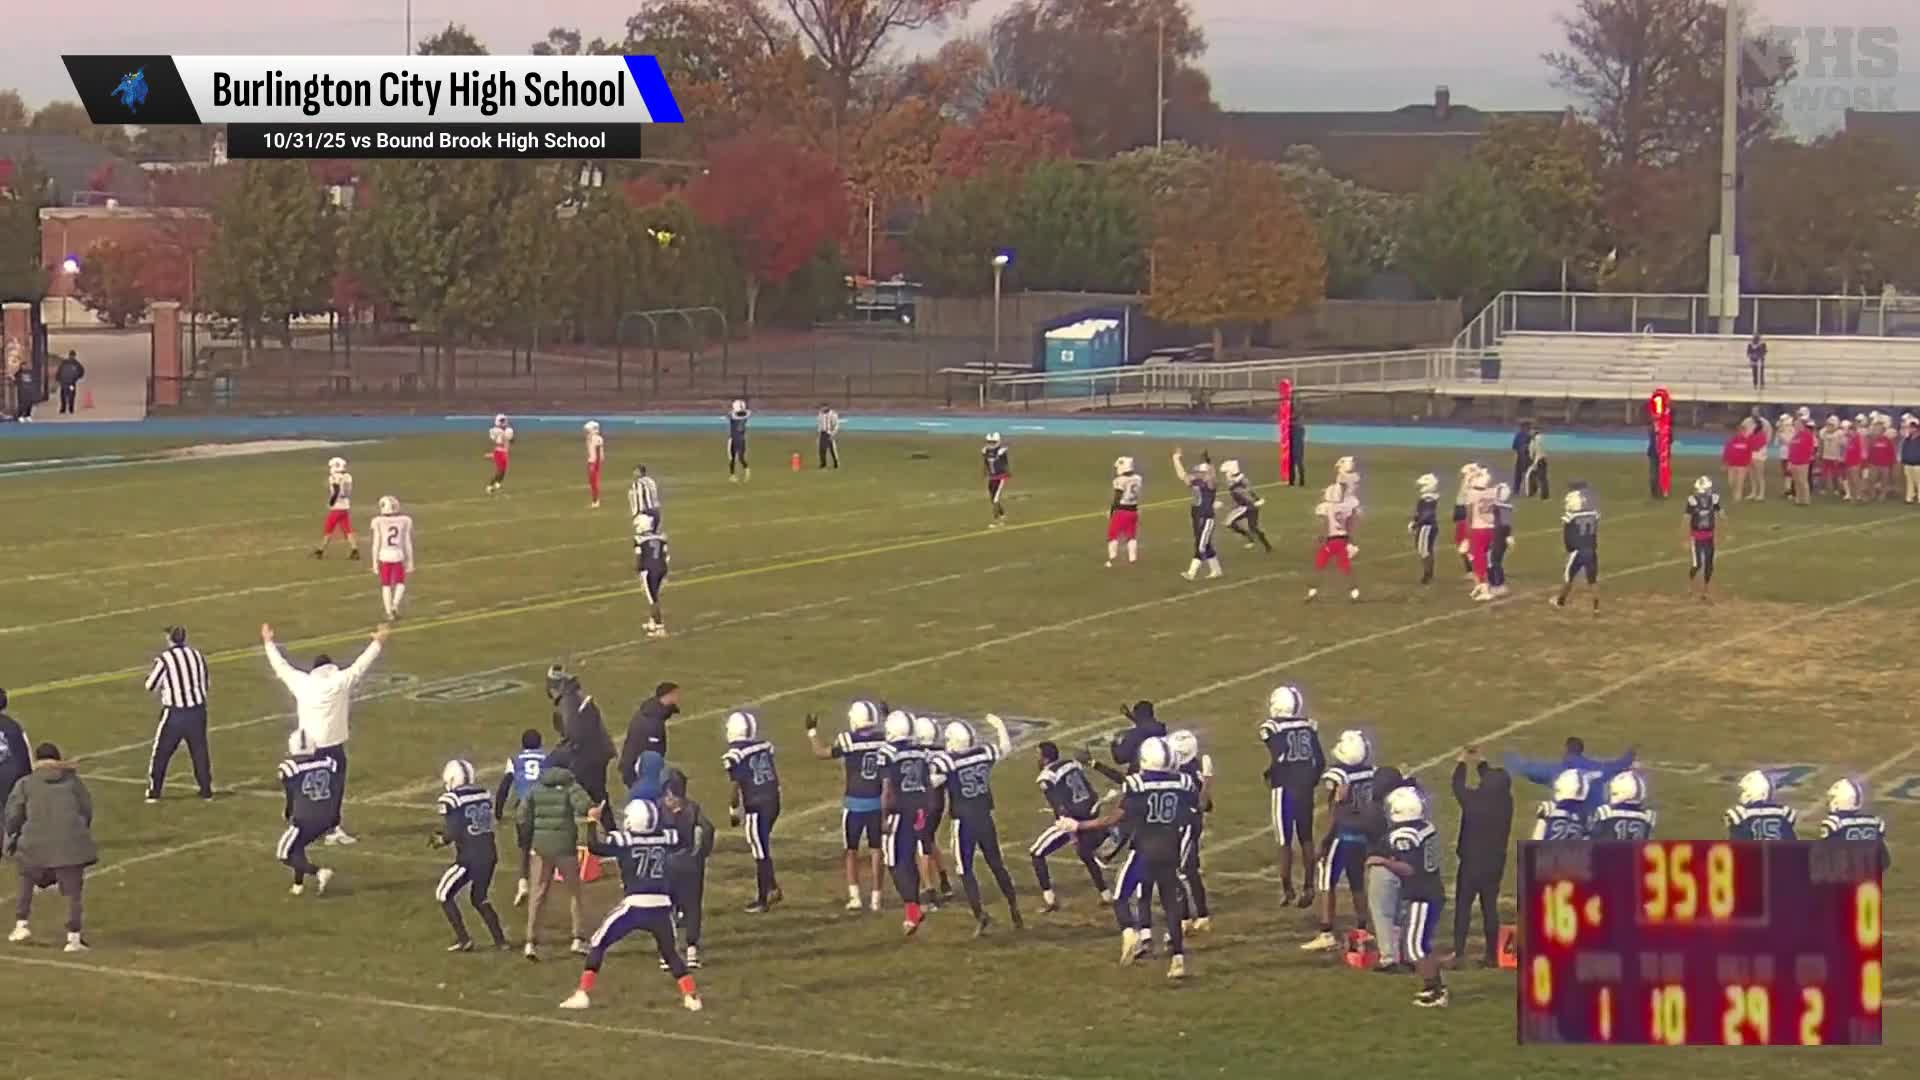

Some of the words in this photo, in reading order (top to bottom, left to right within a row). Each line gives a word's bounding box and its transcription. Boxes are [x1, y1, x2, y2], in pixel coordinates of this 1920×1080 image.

[1654, 395, 1663, 414] 1
[387, 526, 399, 547] 2
[301, 768, 331, 801] 42
[524, 760, 540, 781] 9
[1147, 792, 1178, 823] 18
[631, 846, 666, 879] 72
[1543, 880, 1578, 944] 16
[1856, 880, 1882, 946] 0
[1599, 986, 1612, 1041] 1
[1652, 984, 1687, 1045] 10
